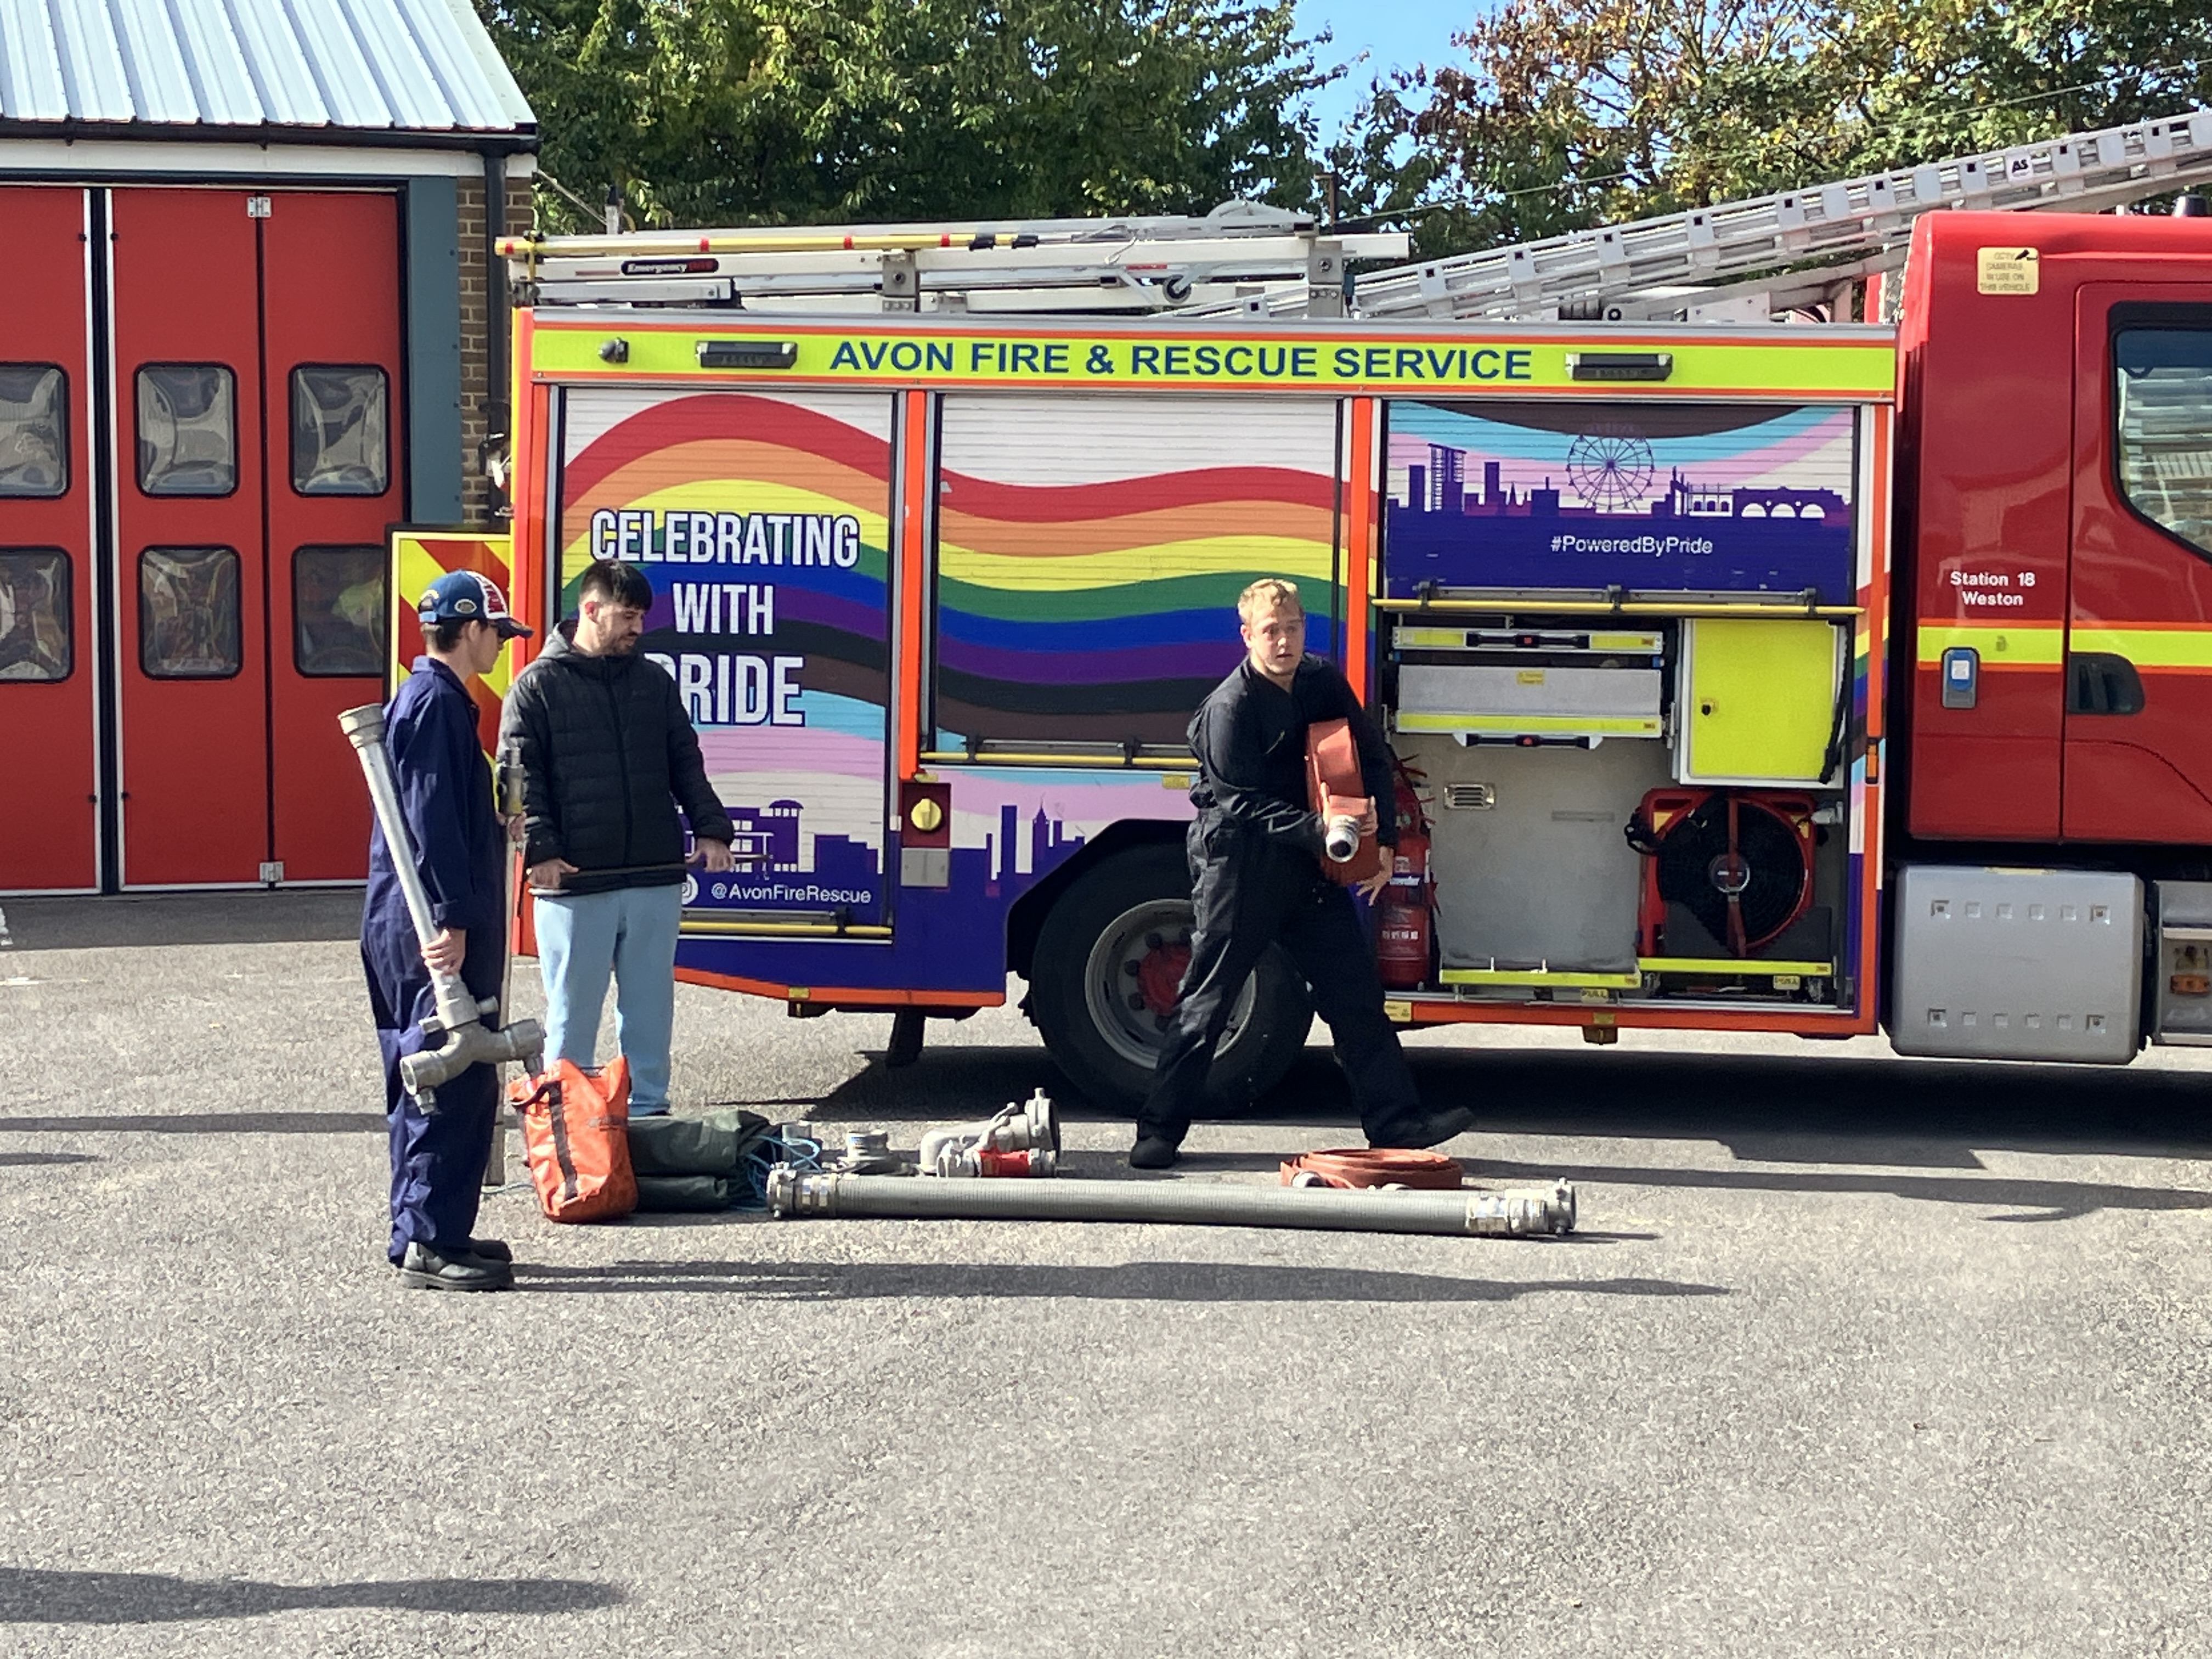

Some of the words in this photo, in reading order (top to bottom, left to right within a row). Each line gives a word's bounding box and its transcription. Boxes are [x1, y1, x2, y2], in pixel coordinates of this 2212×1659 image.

[830, 341, 953, 371] AVON
[970, 342, 1069, 373] FIRE
[1085, 345, 1114, 374] &
[1131, 346, 1317, 376] RESCUE
[1333, 348, 1532, 380] SERVICE
[591, 509, 859, 568] CELEBRATING
[1550, 535, 1713, 557] #PoweredByPride
[1950, 571, 2009, 586] Station
[2017, 572, 2035, 586] 18
[672, 583, 774, 635] WITH
[1962, 591, 2023, 606] Weston
[711, 882, 871, 904] @AvonFireRescue
